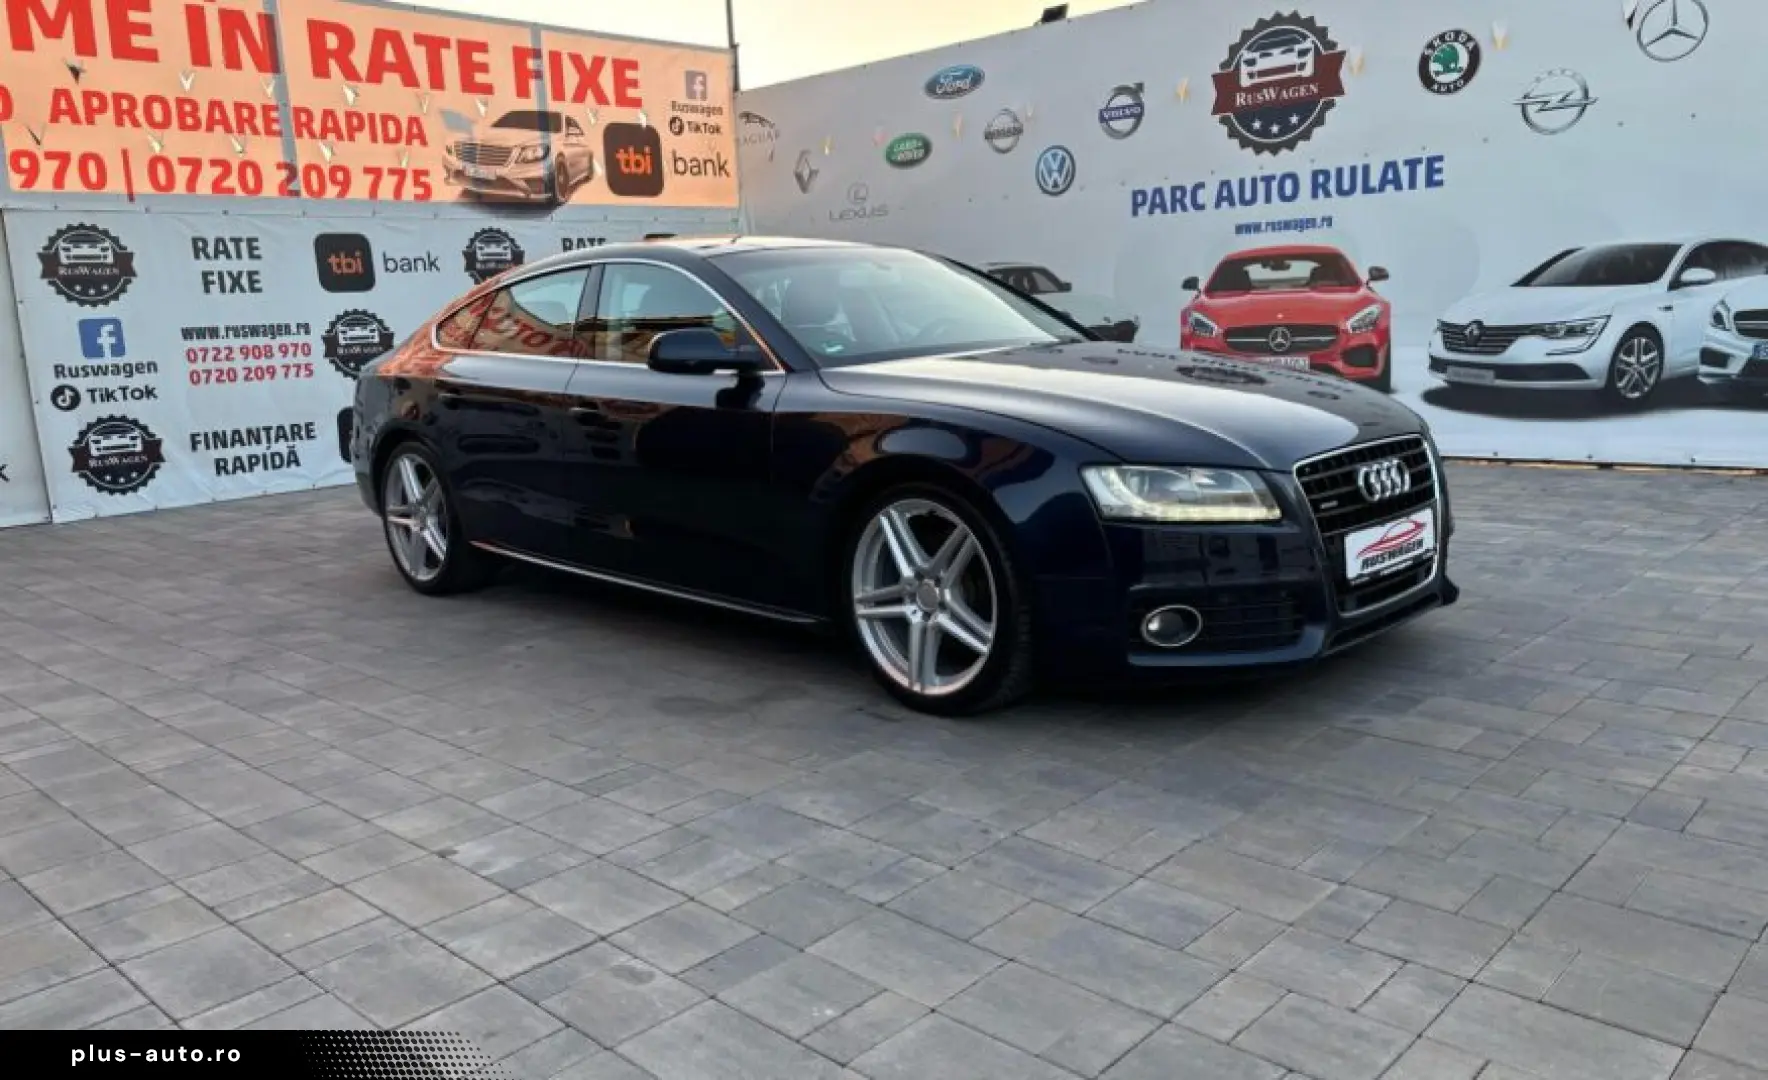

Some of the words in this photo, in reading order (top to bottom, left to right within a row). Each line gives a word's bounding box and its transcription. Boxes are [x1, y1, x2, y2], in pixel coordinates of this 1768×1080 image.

[5, 0, 160, 63] ME
[307, 20, 496, 96] RATE
[512, 45, 643, 108] FIXE
[49, 88, 282, 137] APROBARE
[293, 106, 428, 147] RAPIDA
[687, 120, 722, 134] TikTok
[9, 148, 108, 191] 970
[147, 156, 263, 195] 0720
[276, 162, 352, 199] 209
[363, 167, 432, 201] 775
[616, 147, 652, 175] tbi
[672, 149, 730, 178] bank
[1131, 181, 1206, 217] PARC
[1214, 171, 1300, 209] AUTO
[1311, 155, 1445, 199] RULATE
[1235, 215, 1333, 235] www.ruswagen.ro
[191, 236, 263, 260] RATE
[327, 253, 363, 275] tbi
[383, 251, 441, 273] bank
[201, 270, 263, 294] FIXE
[181, 322, 312, 341] www.ruswagen.ro
[186, 347, 235, 363] 0722
[240, 345, 274, 359] 908
[278, 343, 312, 357] 970
[54, 360, 158, 379] Ruswagen
[189, 368, 237, 385] 0720
[243, 366, 277, 382] 209
[281, 363, 314, 379] 775
[87, 384, 158, 404] TikTok
[215, 448, 301, 476] RAPIDĂ
